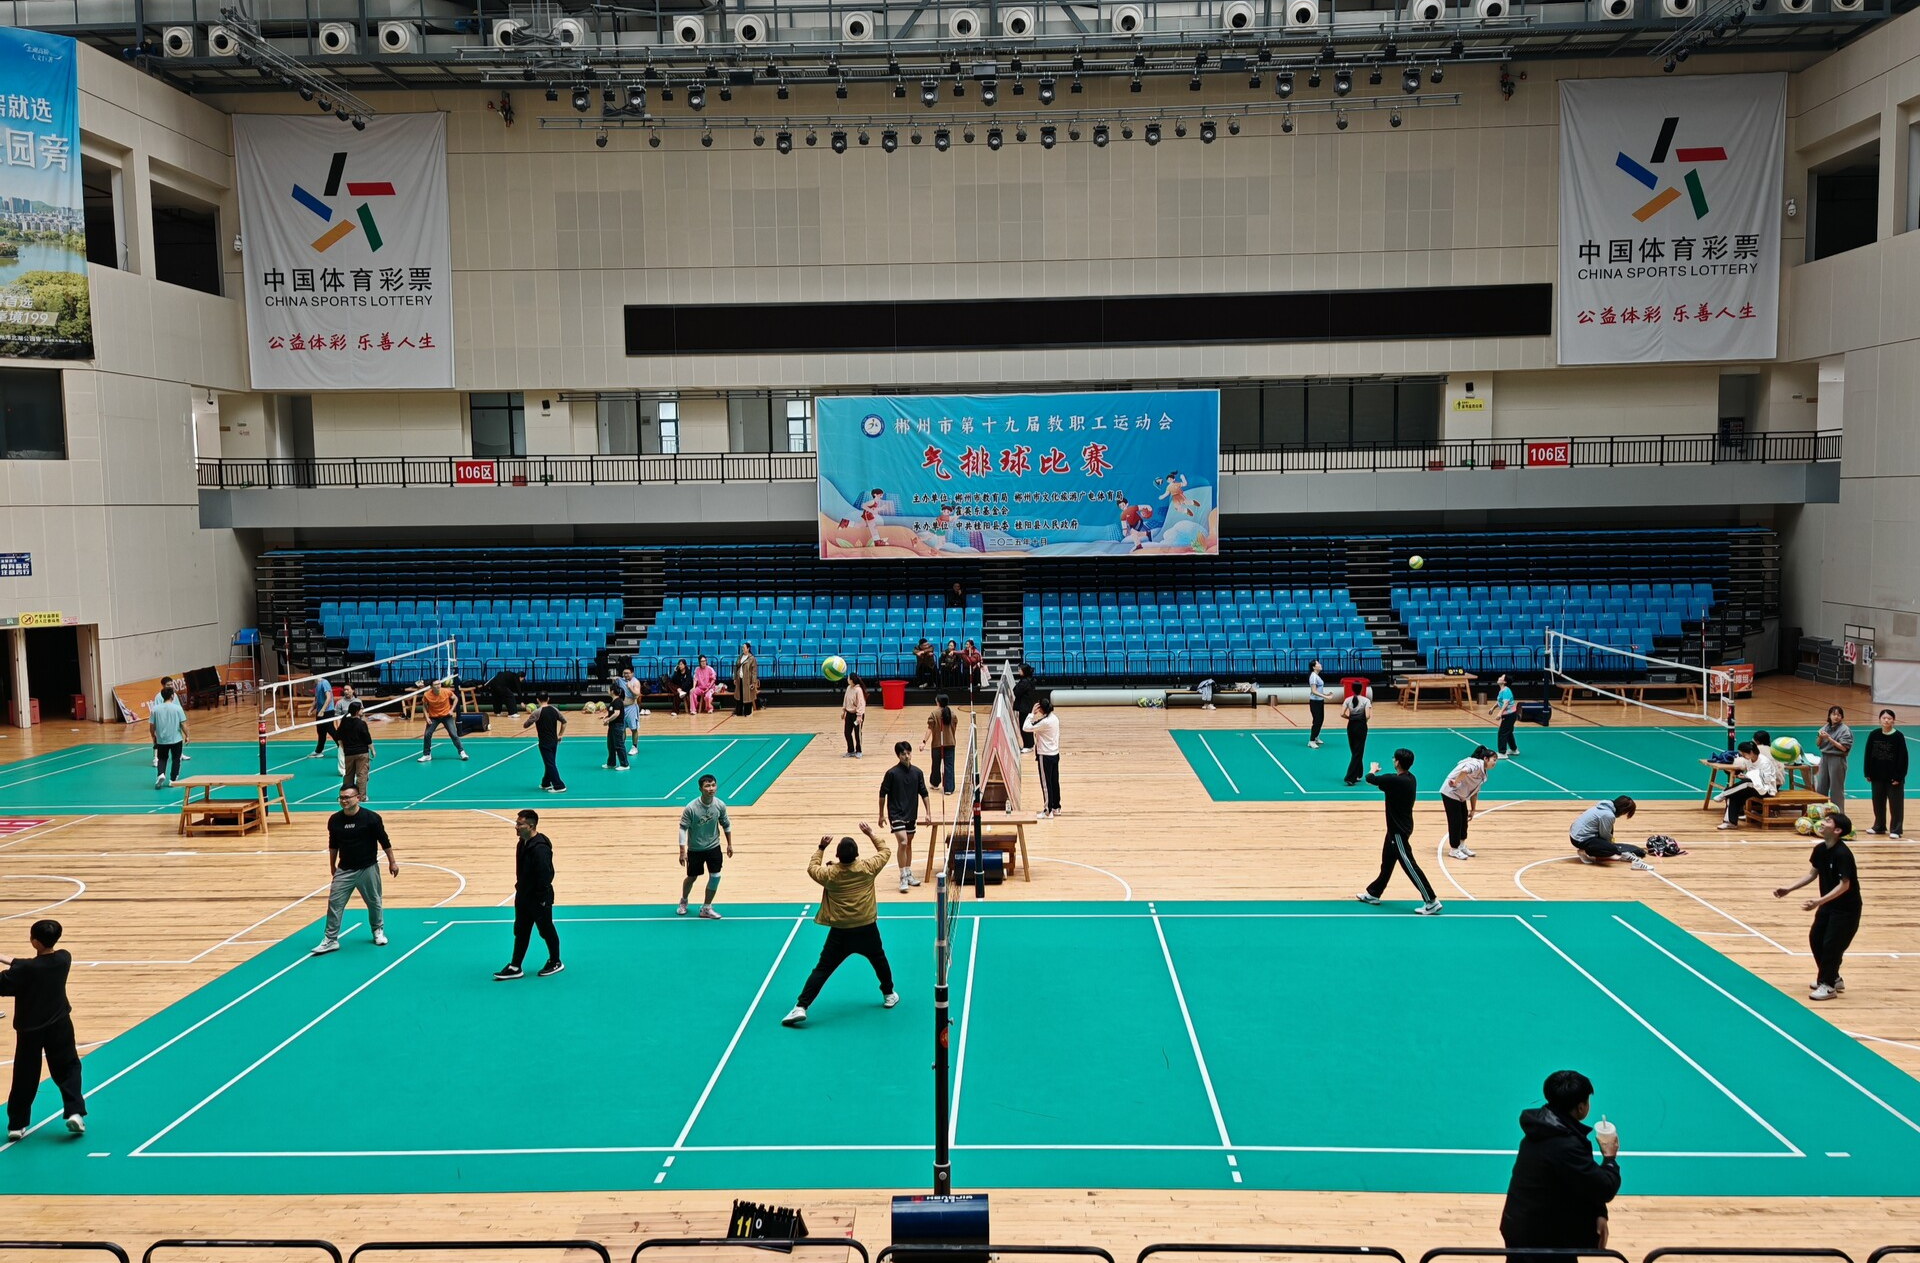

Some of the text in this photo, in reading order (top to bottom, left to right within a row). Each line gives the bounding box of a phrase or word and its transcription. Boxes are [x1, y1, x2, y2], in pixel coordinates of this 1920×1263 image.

[0, 127, 70, 172] 园旁
[1578, 233, 1760, 265] 中国体育彩票
[264, 267, 433, 293] 中国体育彩票
[1577, 262, 1759, 280] CHINA SPORTS LOTTERY
[264, 295, 433, 307] CHINA SPORTS LOTTERY
[1576, 302, 1757, 326] 公益体彩 乐善人生
[267, 332, 436, 351] 公益体彩 乐善人生
[893, 412, 1174, 435] 郴州市第十九届教职工运动会
[921, 441, 1114, 480] 气排球比赛
[1530, 446, 1566, 462] 106区
[458, 465, 492, 480] 106区
[1014, 518, 1079, 530] 桂阳县人民政府
[737, 1215, 763, 1237] 11 0
